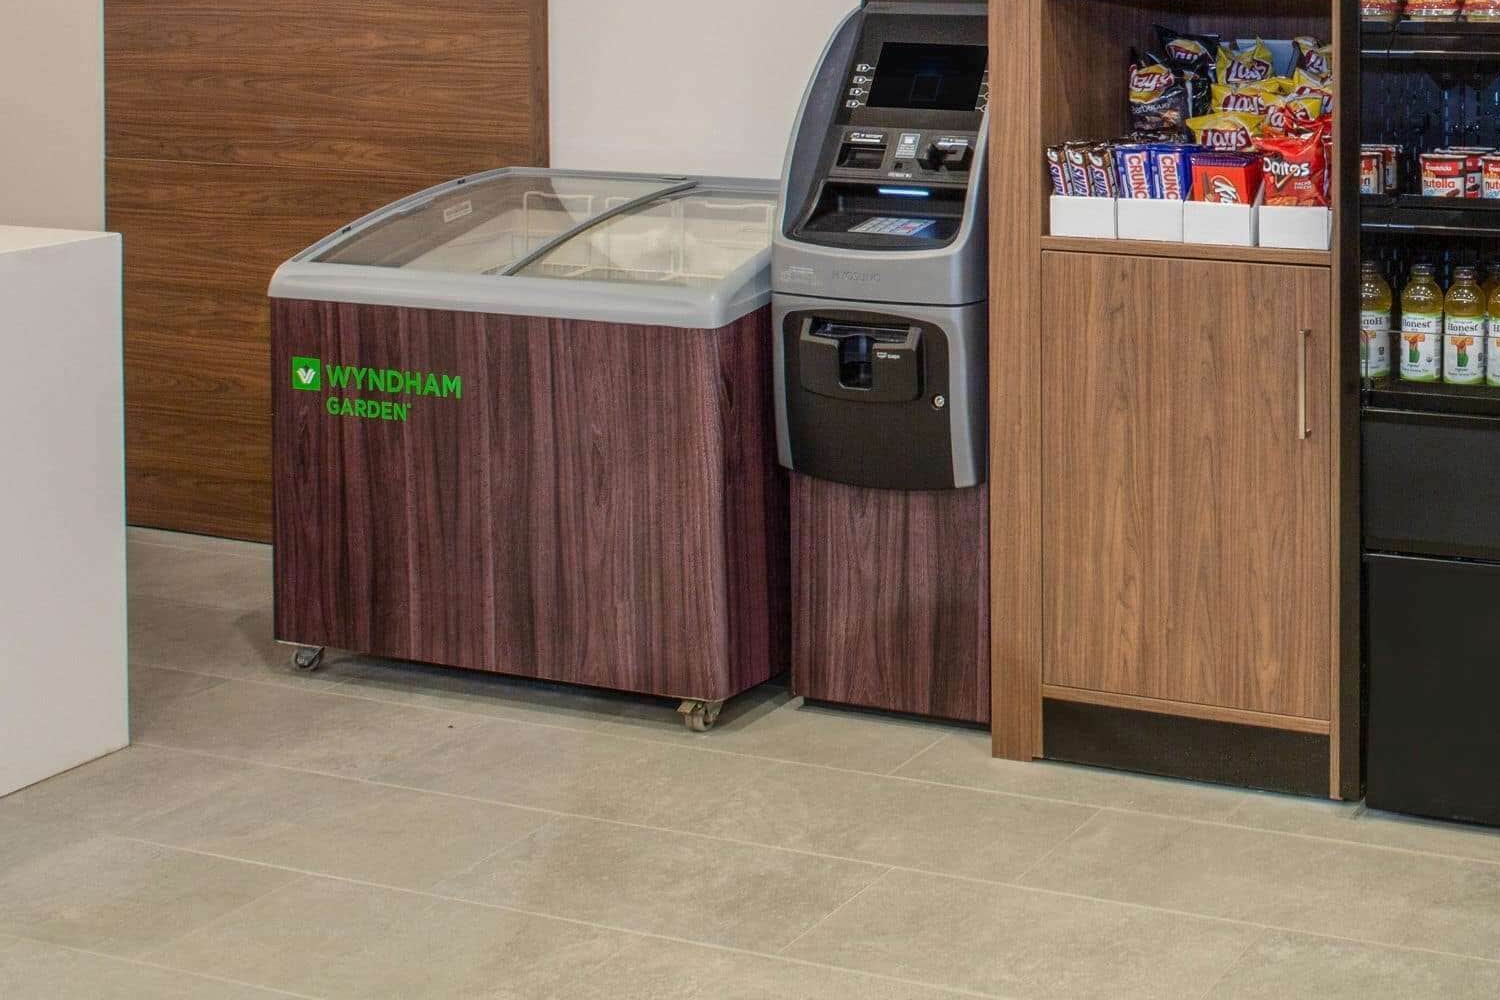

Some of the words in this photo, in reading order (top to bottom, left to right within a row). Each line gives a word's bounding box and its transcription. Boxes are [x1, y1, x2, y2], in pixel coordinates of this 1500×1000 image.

[1128, 155, 1148, 199] CRUNC
[1160, 155, 1178, 199] CRUNC
[1263, 157, 1310, 177] Doritos
[1424, 177, 1456, 189] nutella
[326, 364, 462, 399] WYNDHAM
[326, 396, 407, 422] GARDEN
